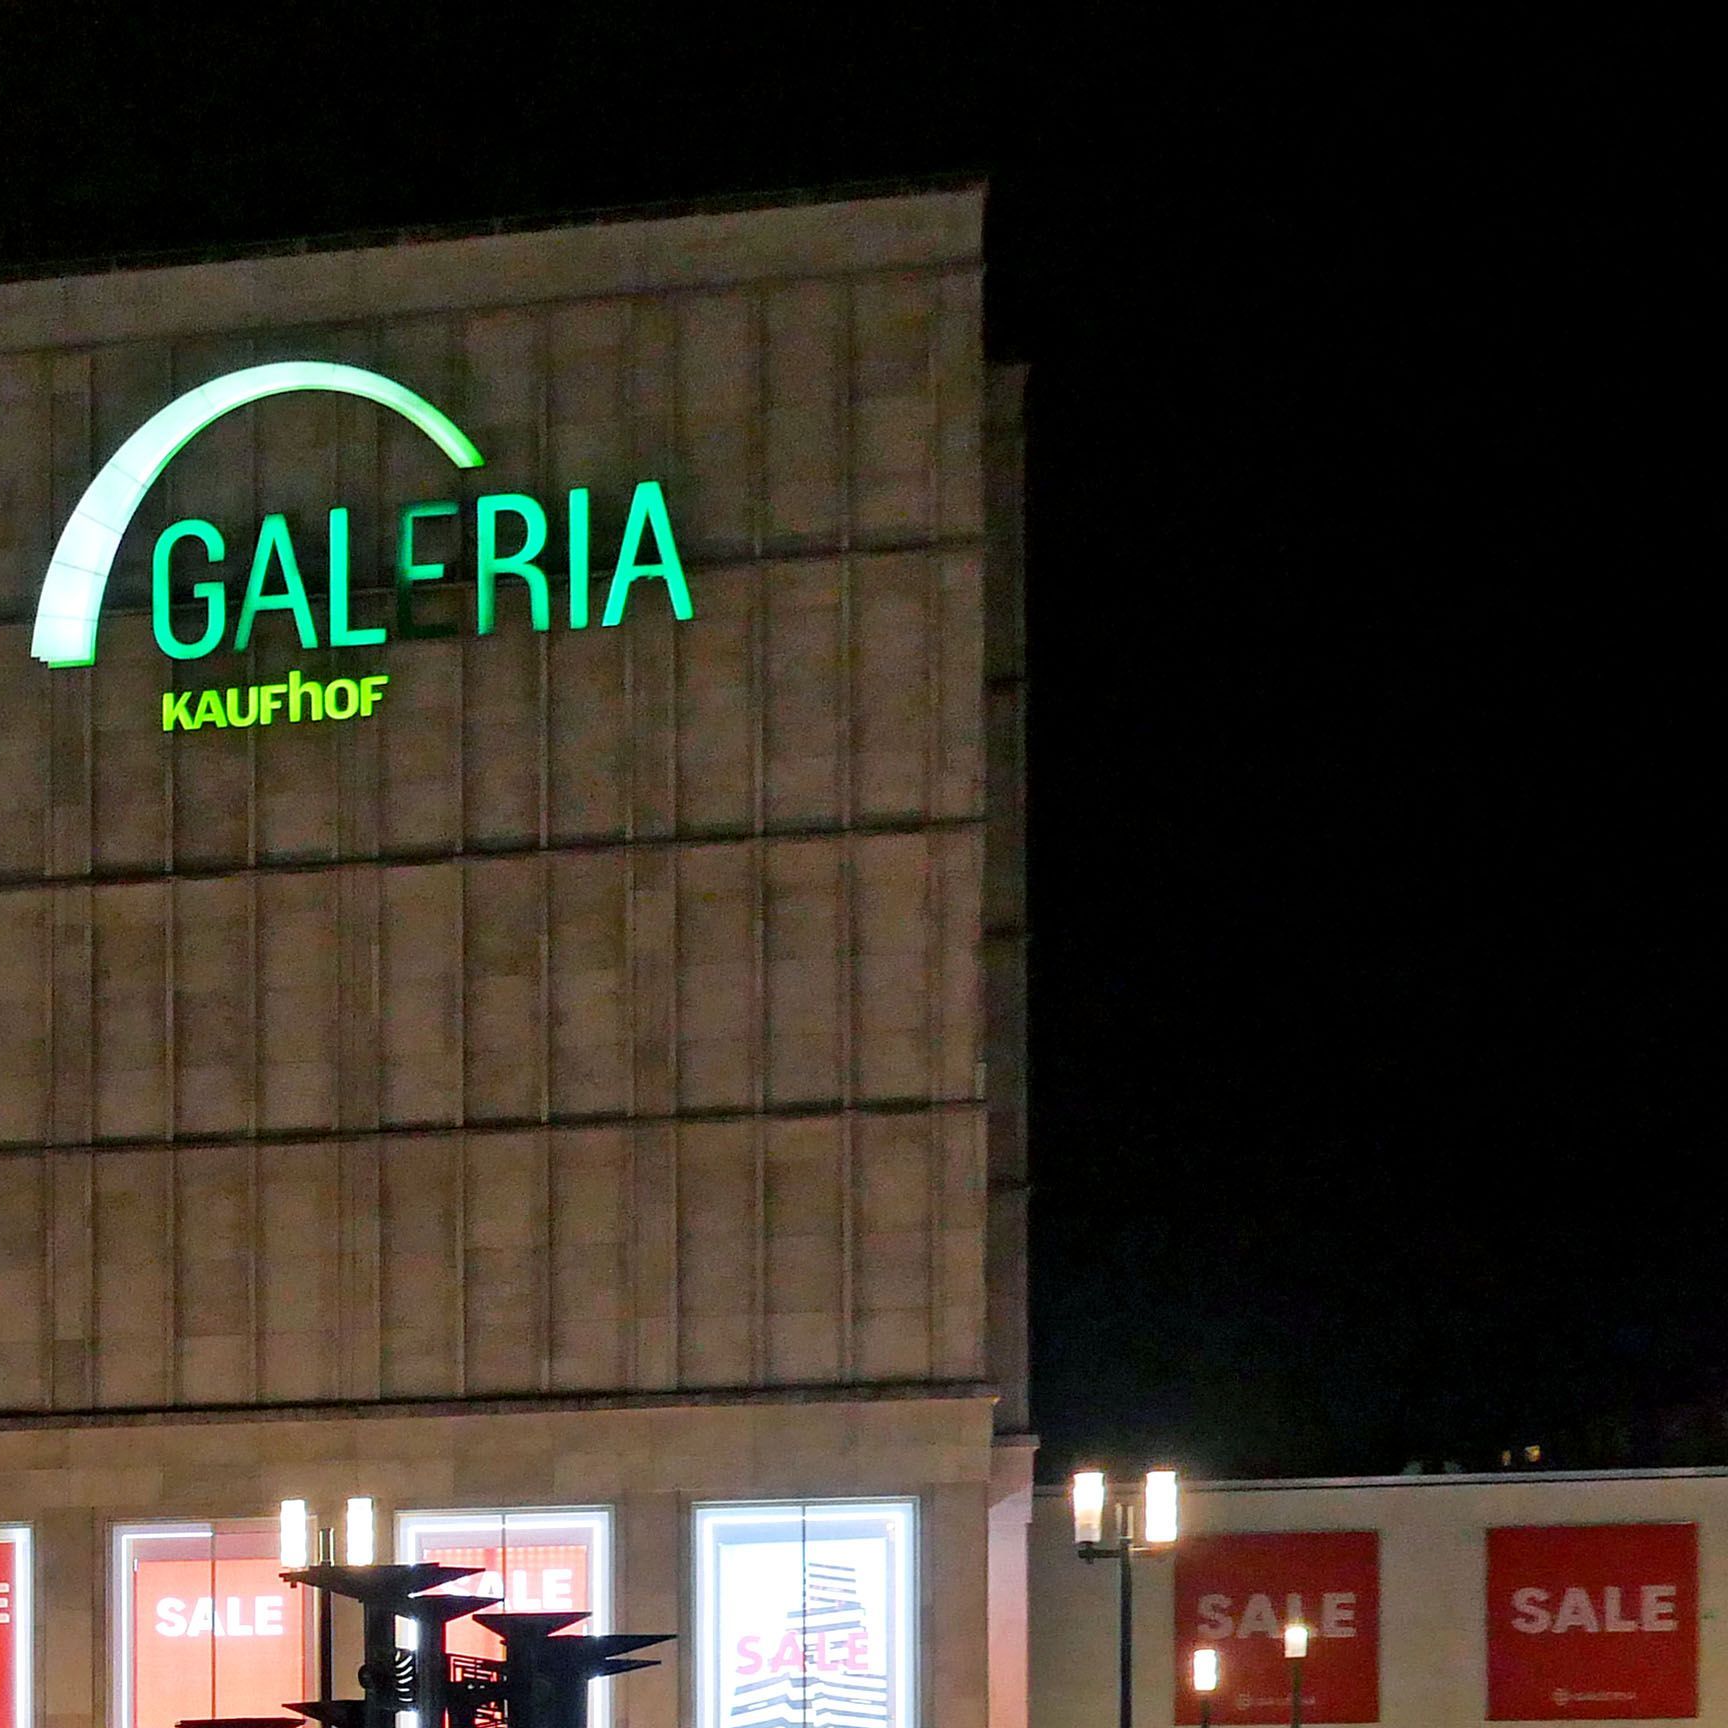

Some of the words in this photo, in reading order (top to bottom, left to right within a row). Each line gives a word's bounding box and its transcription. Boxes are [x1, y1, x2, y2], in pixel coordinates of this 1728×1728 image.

[152, 480, 695, 660] GALERIA
[156, 1596, 284, 1638] SALE
[1197, 1592, 1357, 1640] SALE
[1511, 1585, 1678, 1634] SALE
[735, 1631, 869, 1675] SALE
